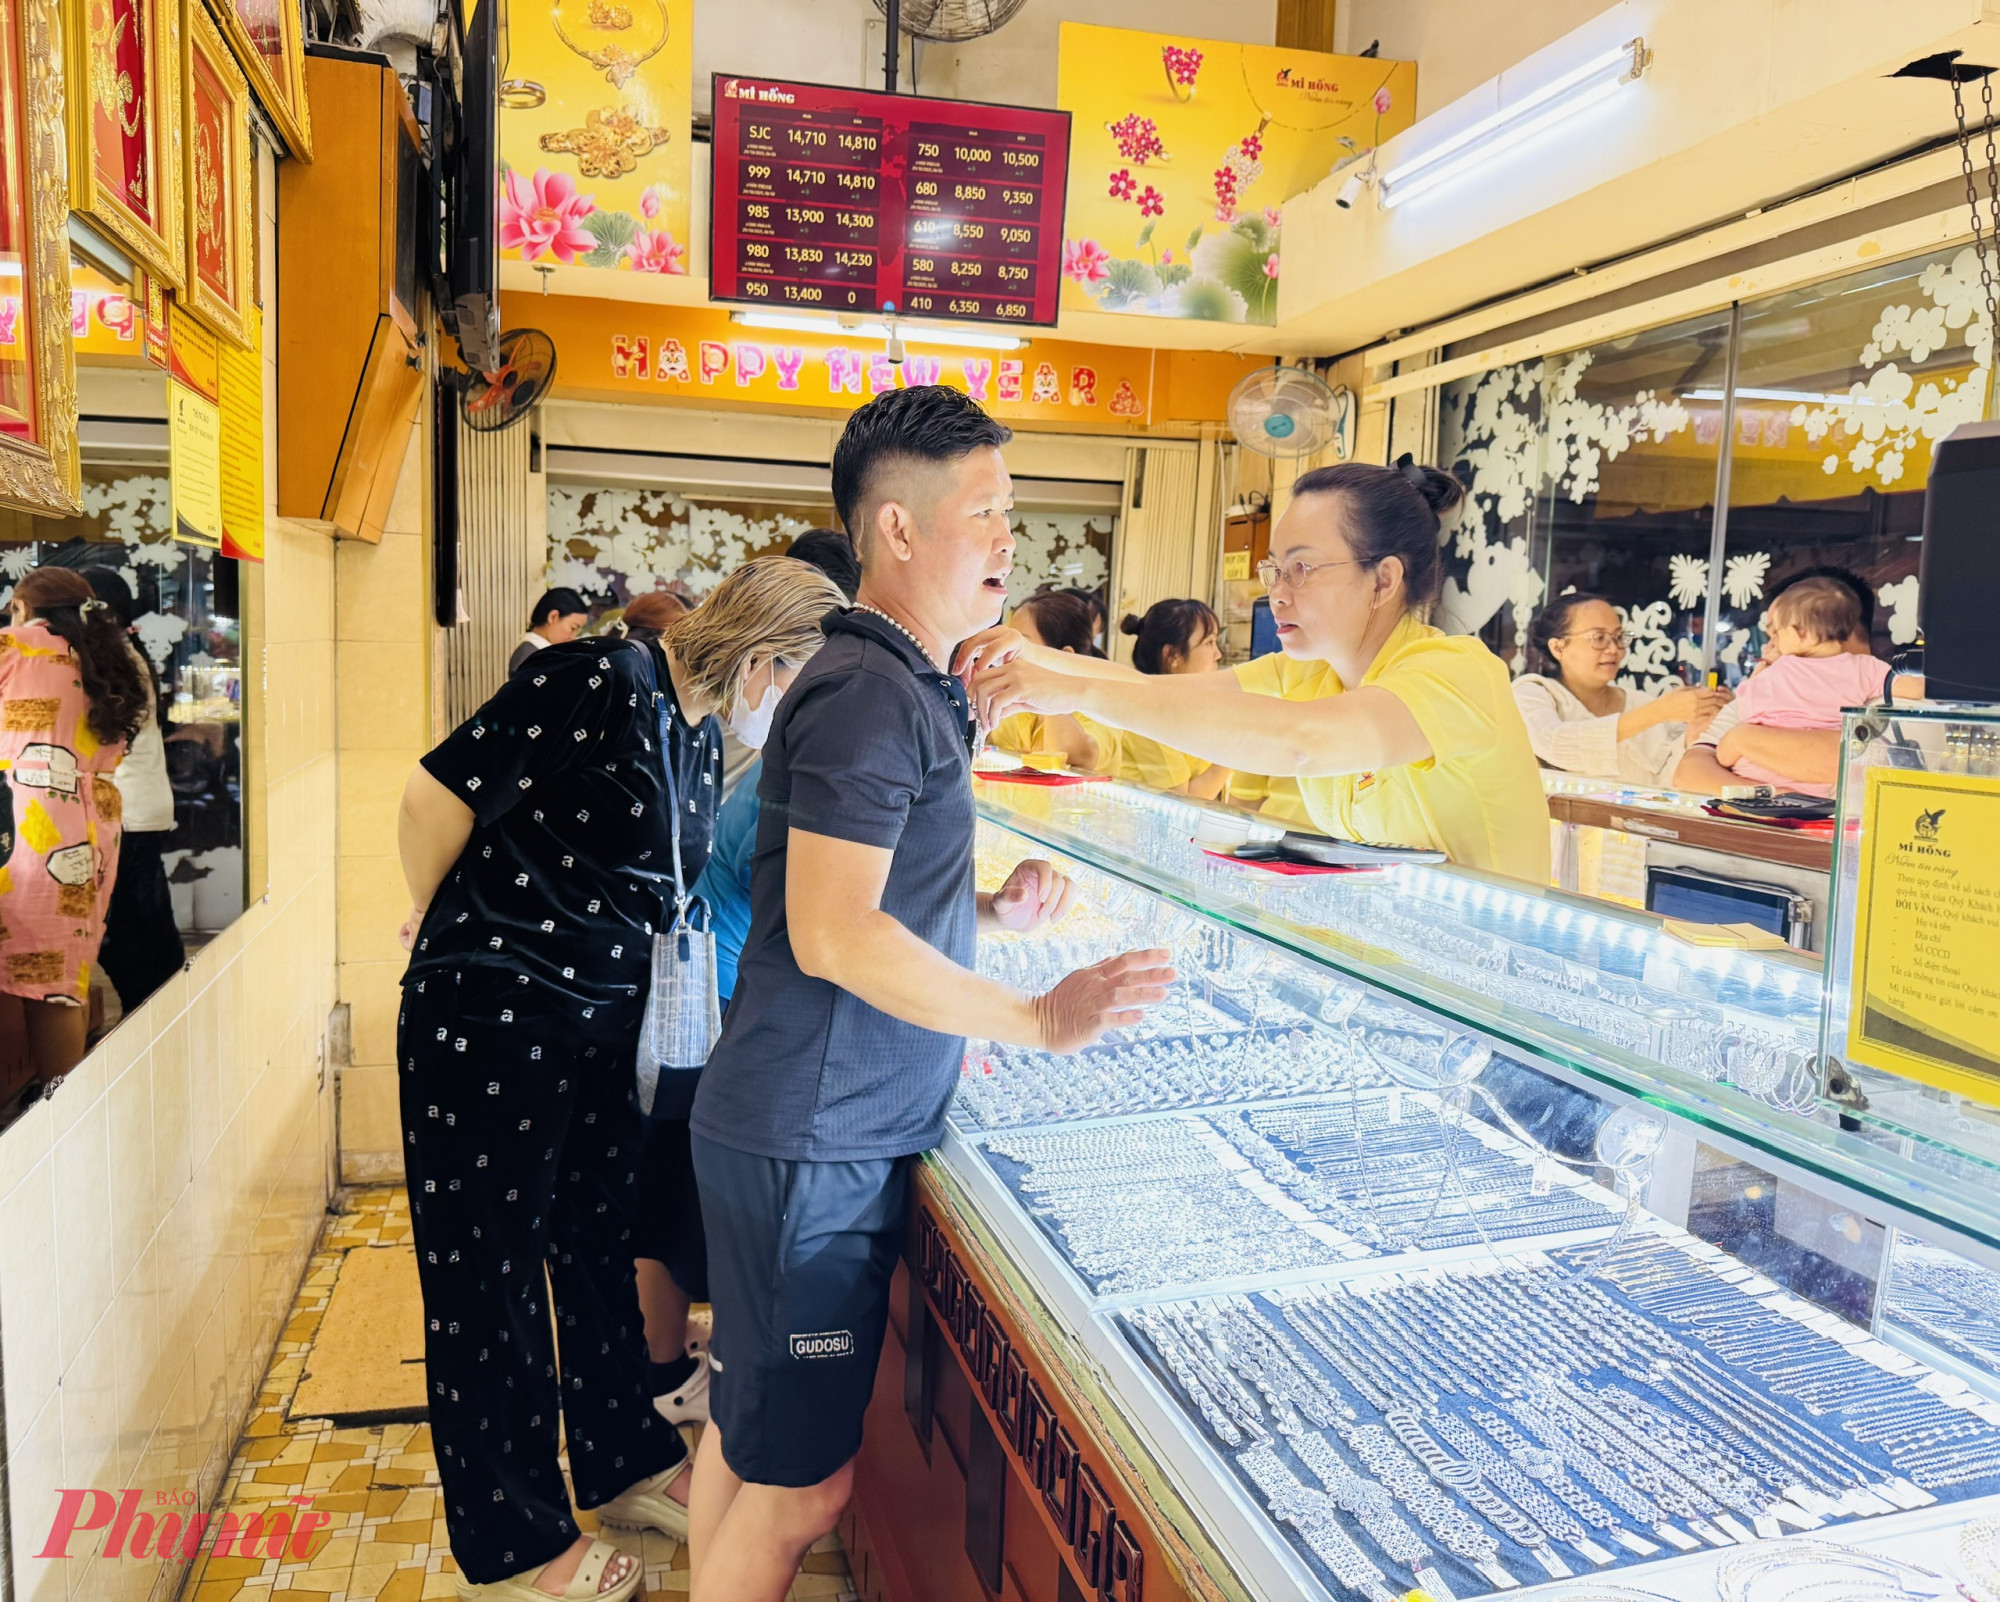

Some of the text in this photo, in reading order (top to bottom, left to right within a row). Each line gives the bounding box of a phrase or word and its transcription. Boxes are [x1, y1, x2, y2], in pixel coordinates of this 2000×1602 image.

[749, 125, 877, 151] SJC 14,710 14,810
[918, 143, 1039, 167] 750 10,000 10,500
[748, 165, 875, 190] 999 14,710 14,810
[915, 181, 1033, 205] 680 8,850 9,350
[747, 204, 874, 228] 985 13,900 14,300
[914, 221, 1031, 243] 610 8,550 9,050
[746, 244, 873, 267] 980 13,830 14,230
[912, 258, 1029, 280] 580 8,250 8,750
[746, 282, 856, 304] 950 13,400 0
[910, 297, 1026, 317] 410 6,350 6,850
[611, 334, 1099, 407] HAPPY NEW YEAR
[1897, 873, 1915, 883] Theo
[796, 1335, 849, 1354] GUDOSU
